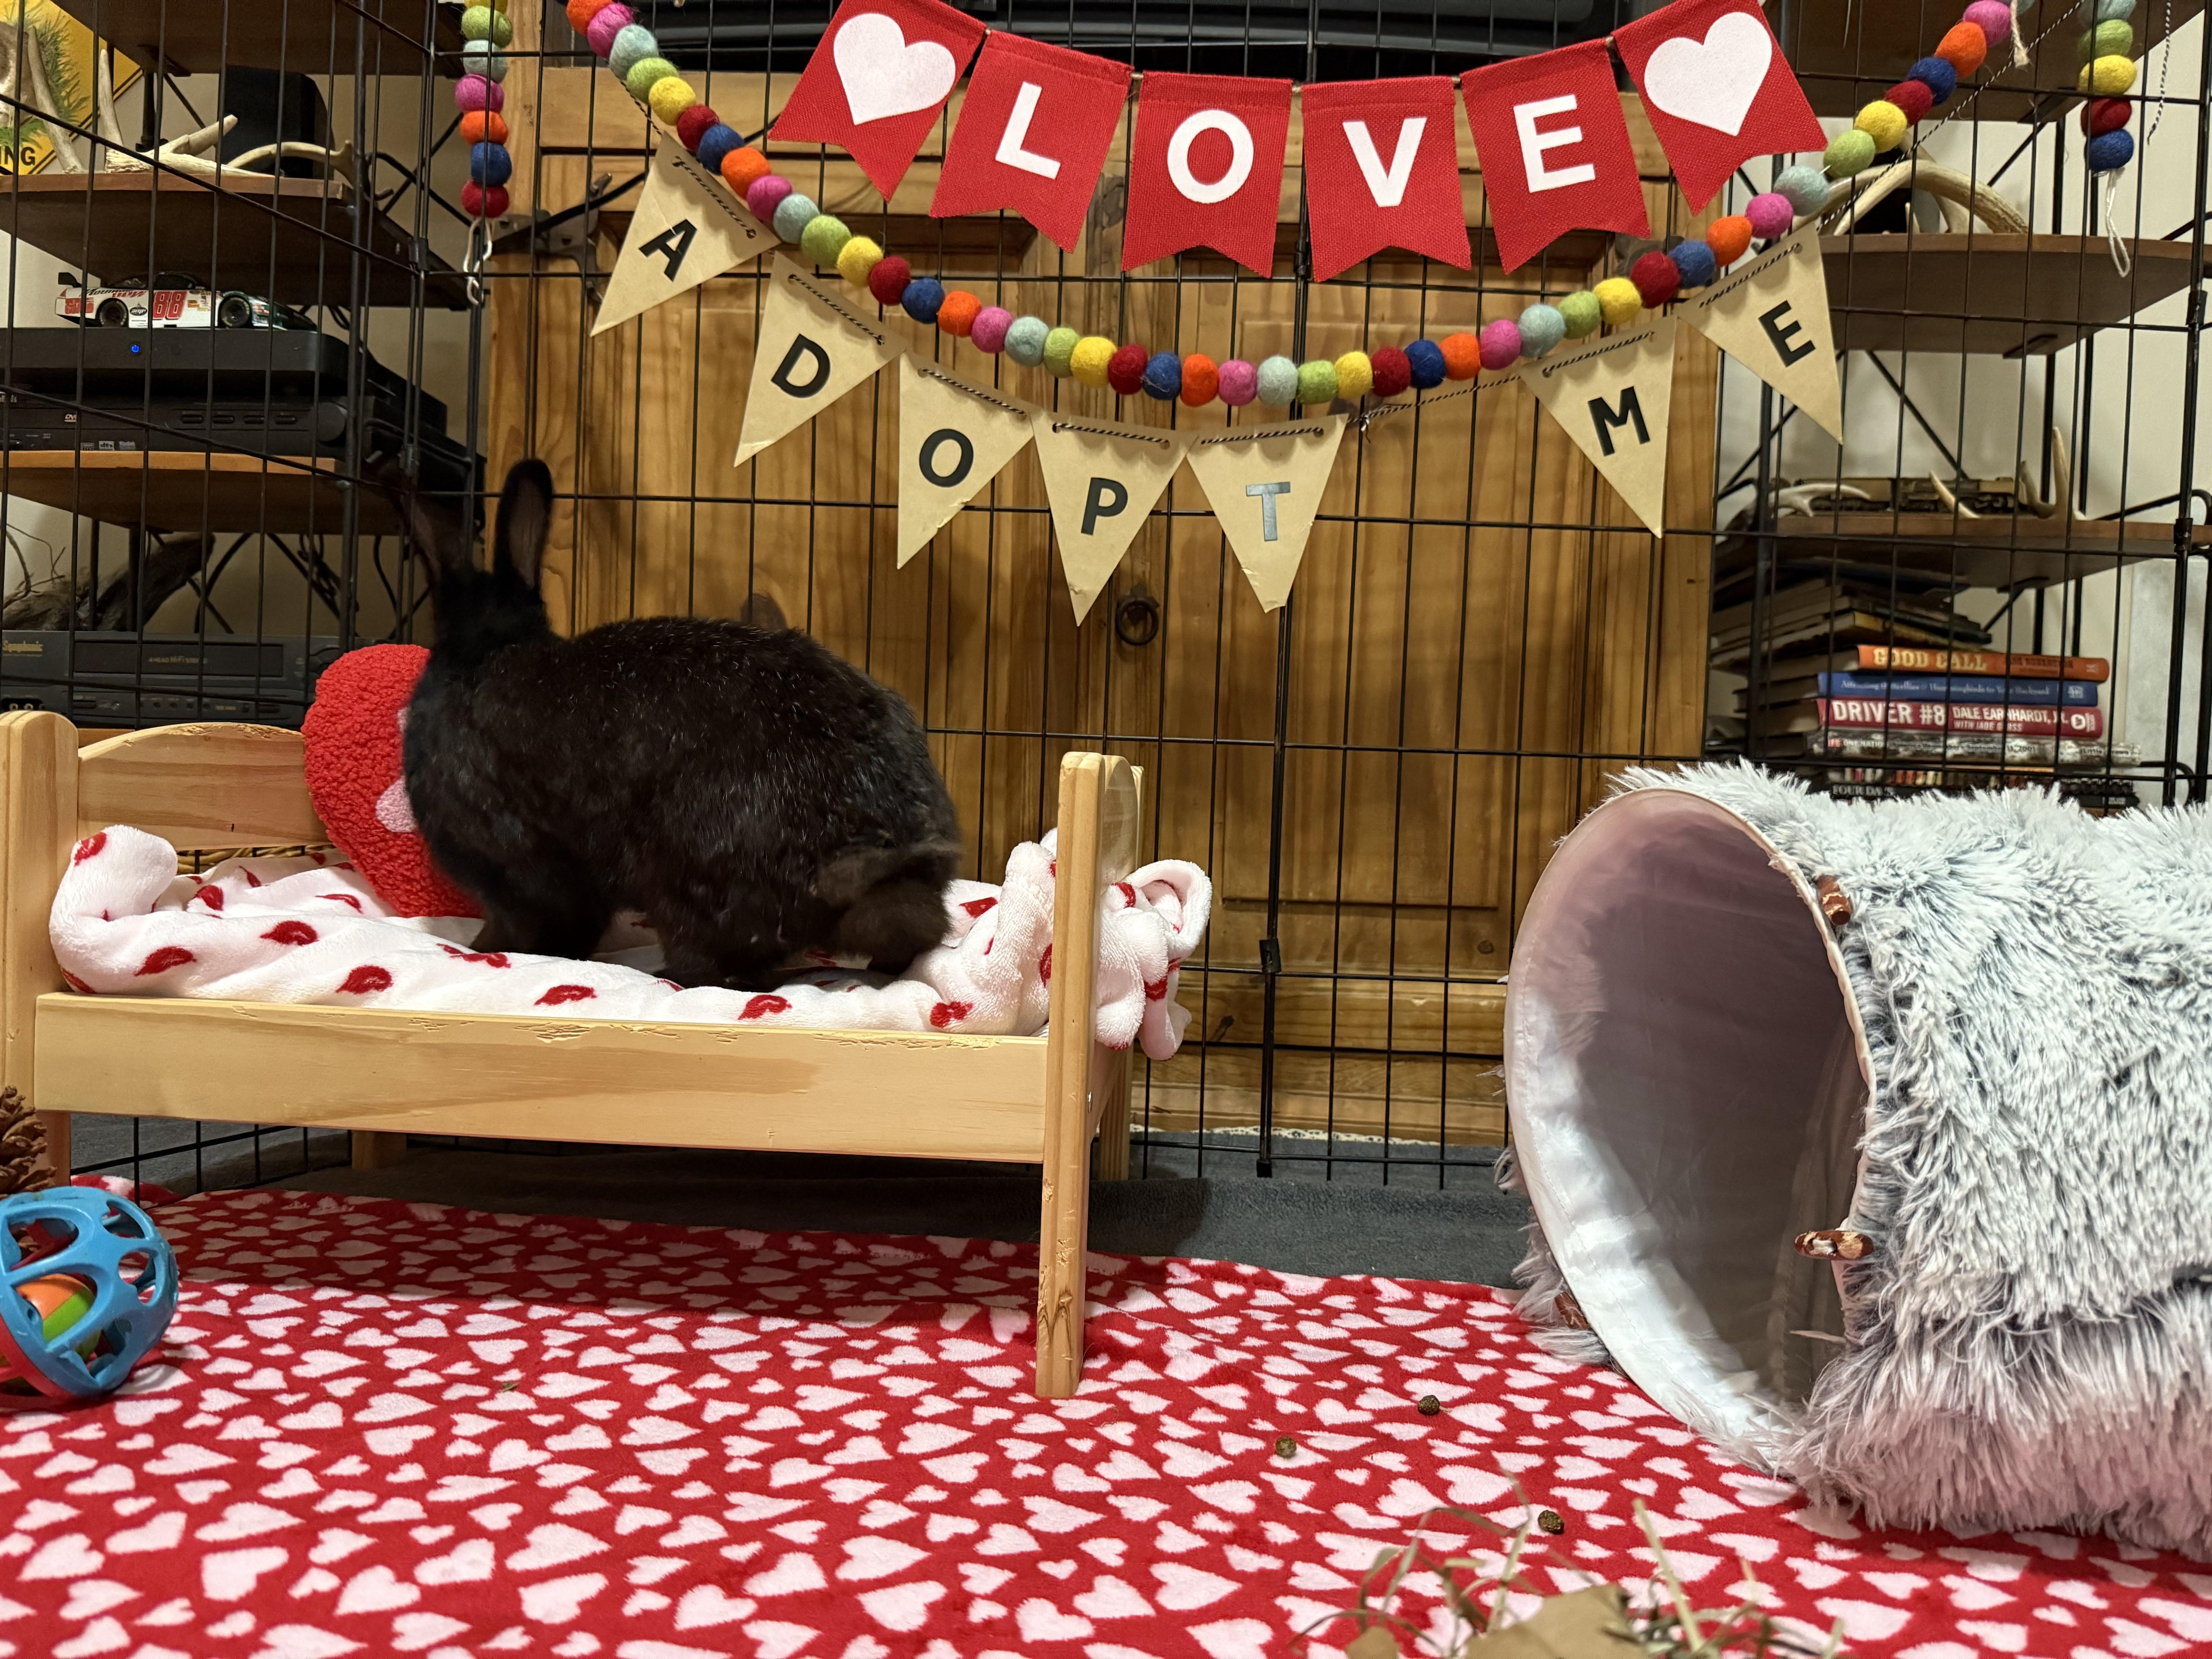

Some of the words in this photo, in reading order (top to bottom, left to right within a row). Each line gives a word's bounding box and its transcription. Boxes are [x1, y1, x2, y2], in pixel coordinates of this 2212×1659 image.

[0, 146, 35, 166] NG
[995, 81, 1595, 207] LOVE
[153, 290, 187, 319] 88
[638, 219, 1291, 542] ADOPT
[1588, 300, 1816, 457] ME
[1873, 648, 1930, 668] GOOD
[1936, 651, 1987, 671] CALL
[1832, 700, 1913, 725] DRIVER
[1920, 704, 1946, 726] #8
[1953, 706, 1981, 720] DALE
[1997, 721, 2023, 732] GRSS
